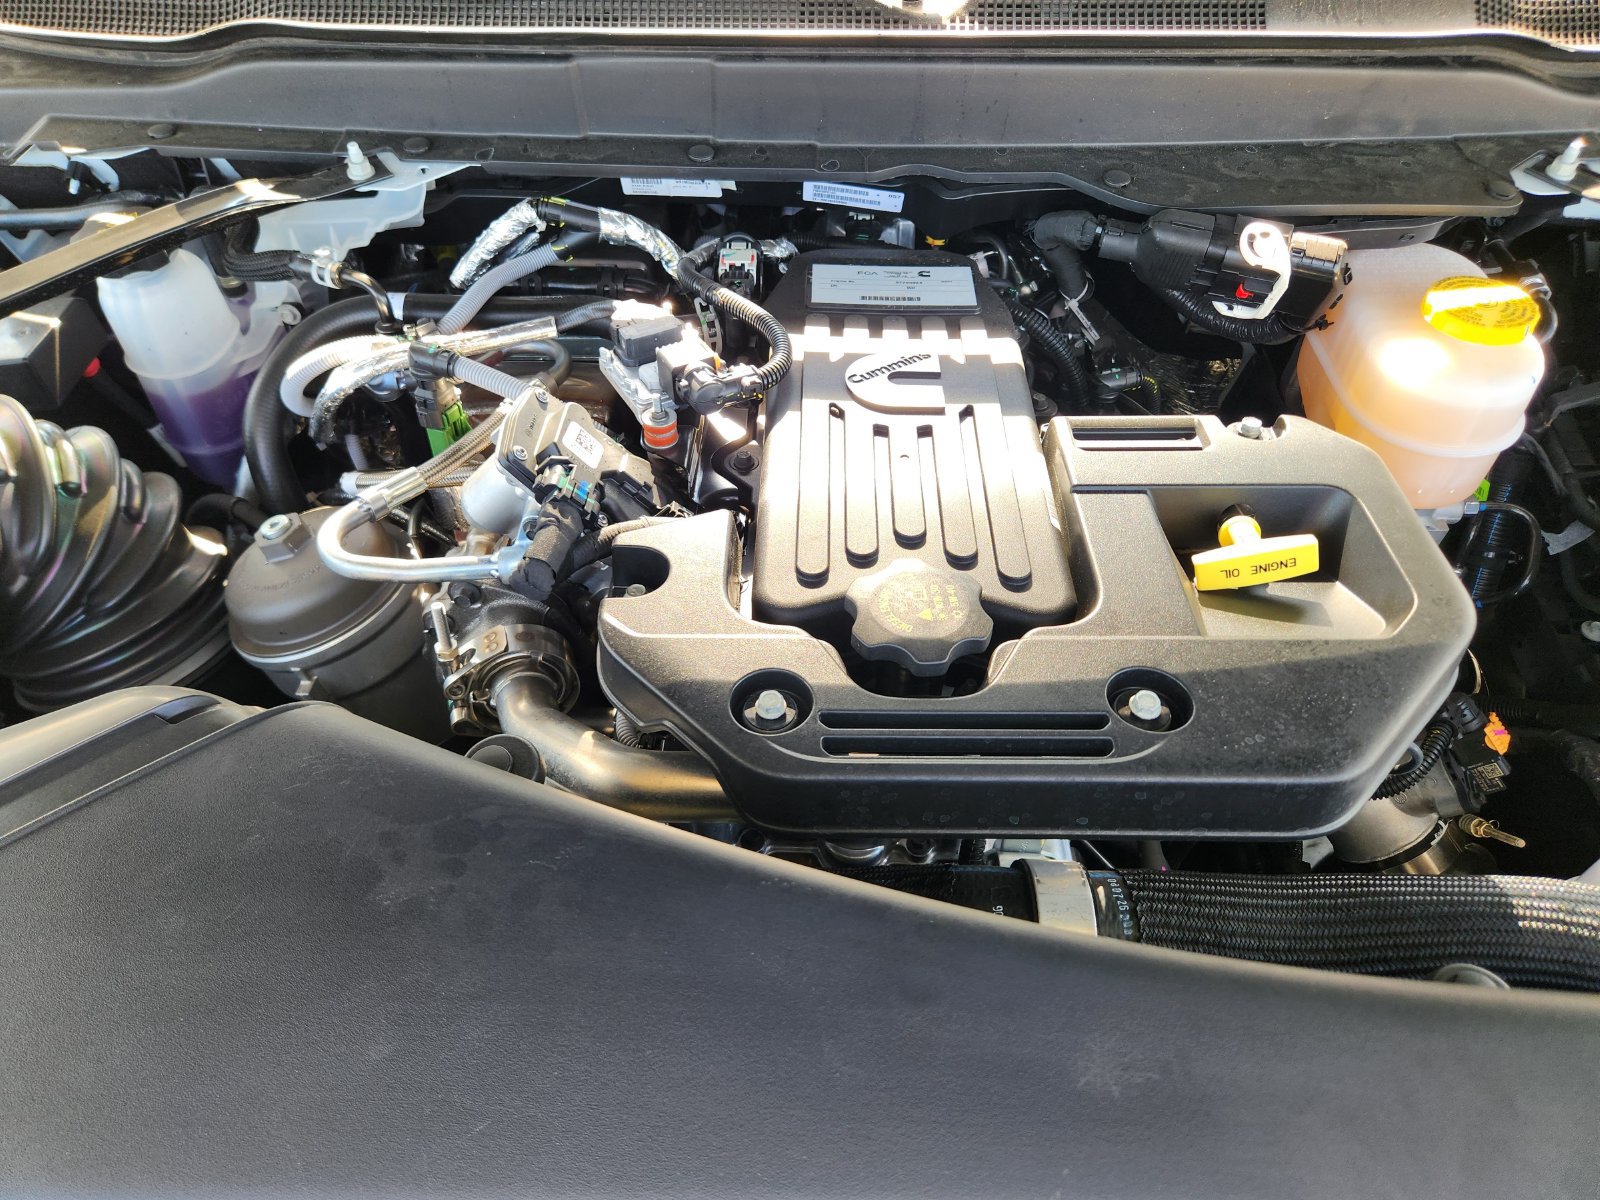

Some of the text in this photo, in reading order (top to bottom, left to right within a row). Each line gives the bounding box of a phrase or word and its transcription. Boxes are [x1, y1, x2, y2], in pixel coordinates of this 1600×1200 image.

[847, 353, 931, 384] Cummins
[1220, 557, 1297, 579] ENGINE OIL
